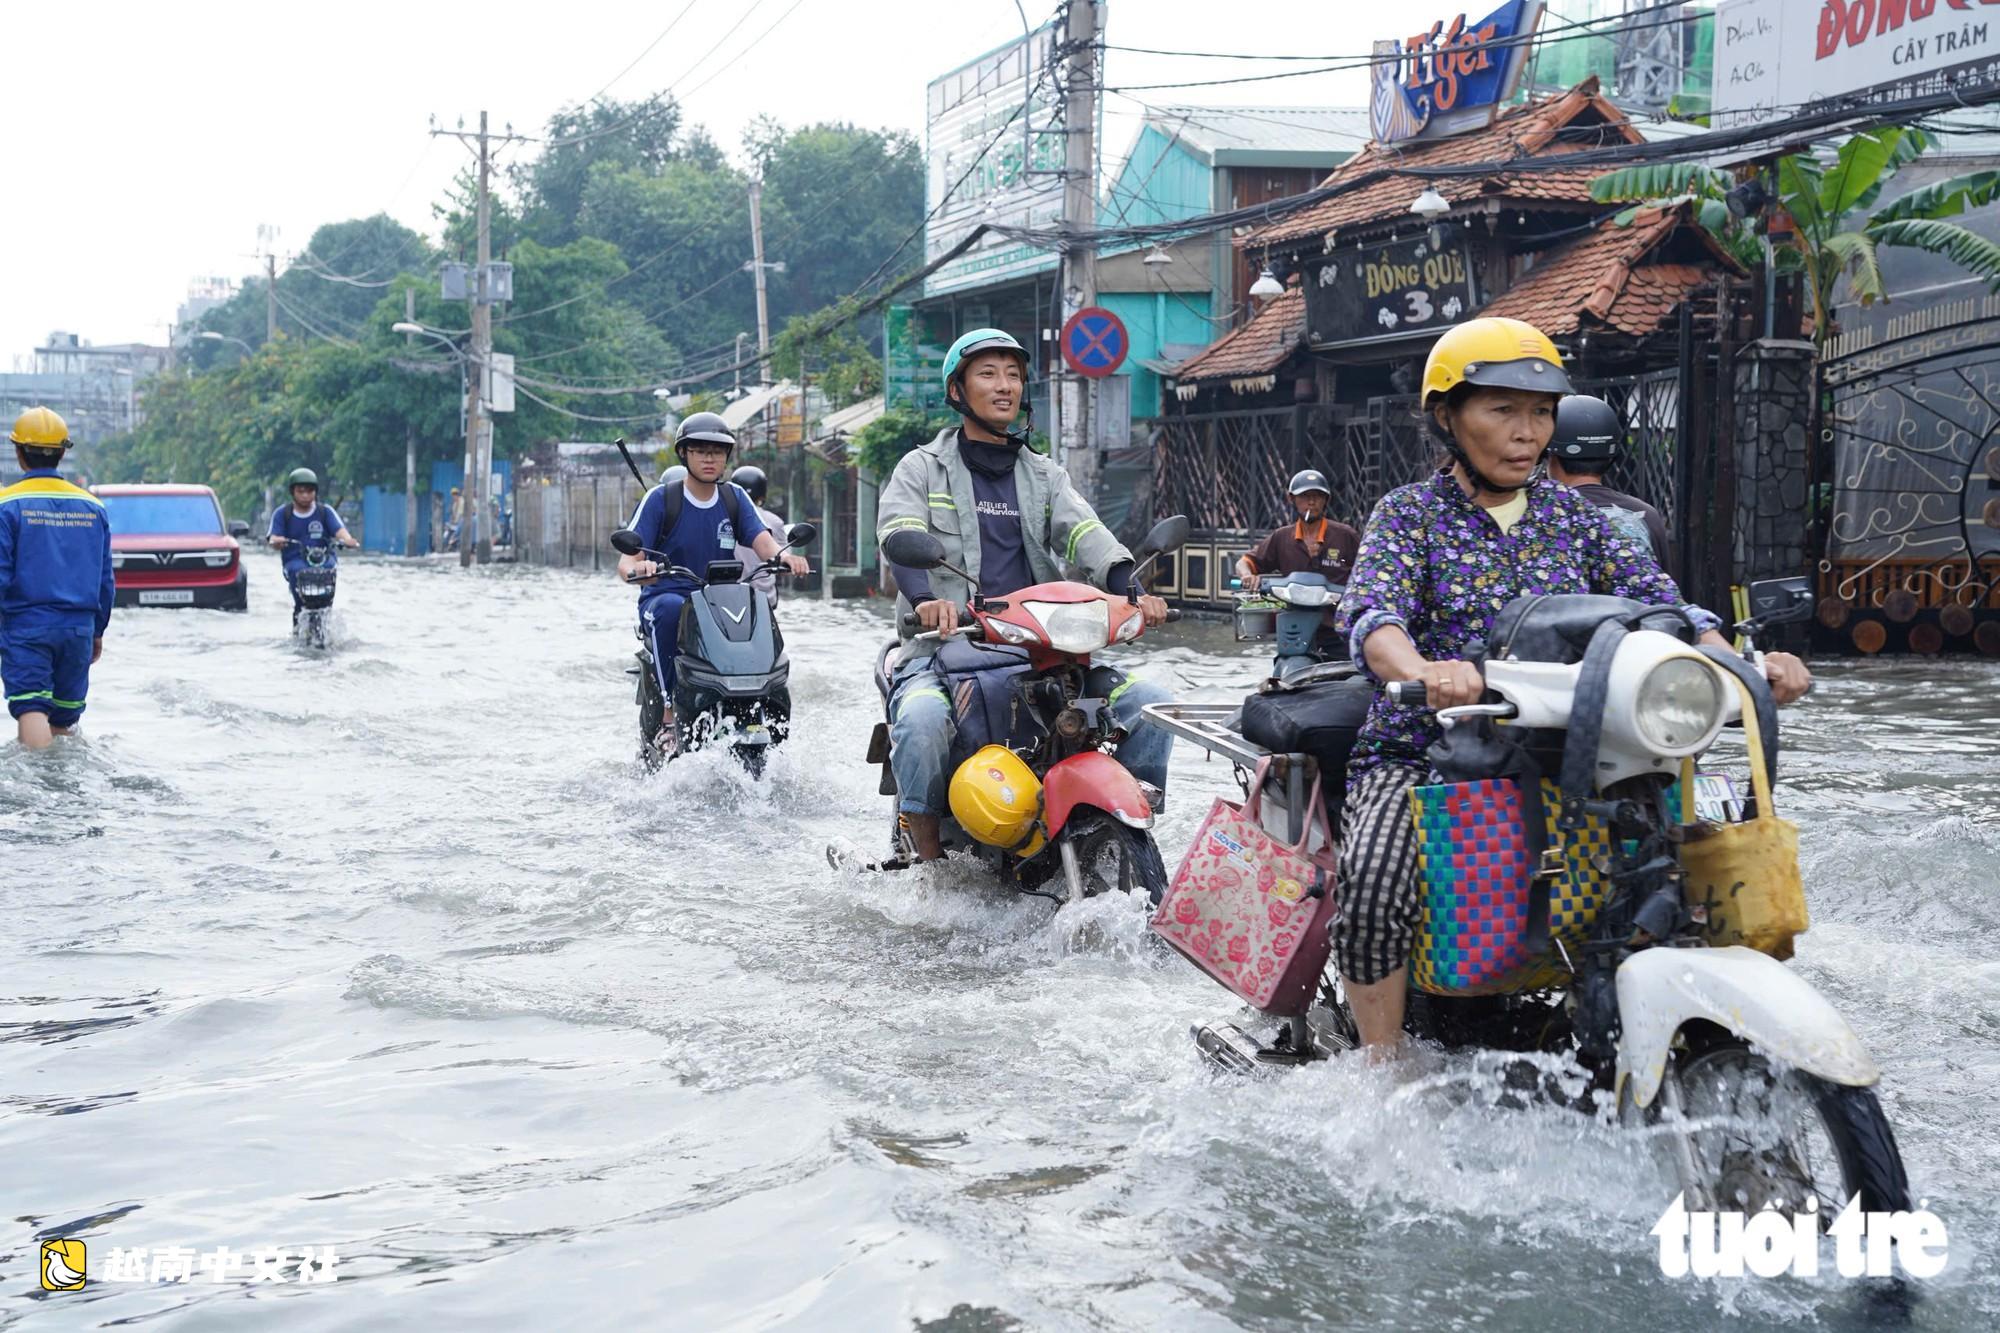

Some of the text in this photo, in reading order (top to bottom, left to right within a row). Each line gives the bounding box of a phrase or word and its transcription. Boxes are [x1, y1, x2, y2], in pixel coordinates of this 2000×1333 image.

[1406, 14, 1496, 110] Tiger
[1892, 22, 1988, 65] CÂY TRÂM
[1365, 249, 1466, 298] ĐỒNG QUÊ
[1404, 290, 1434, 323] 3
[978, 501, 1008, 509] ATELIER
